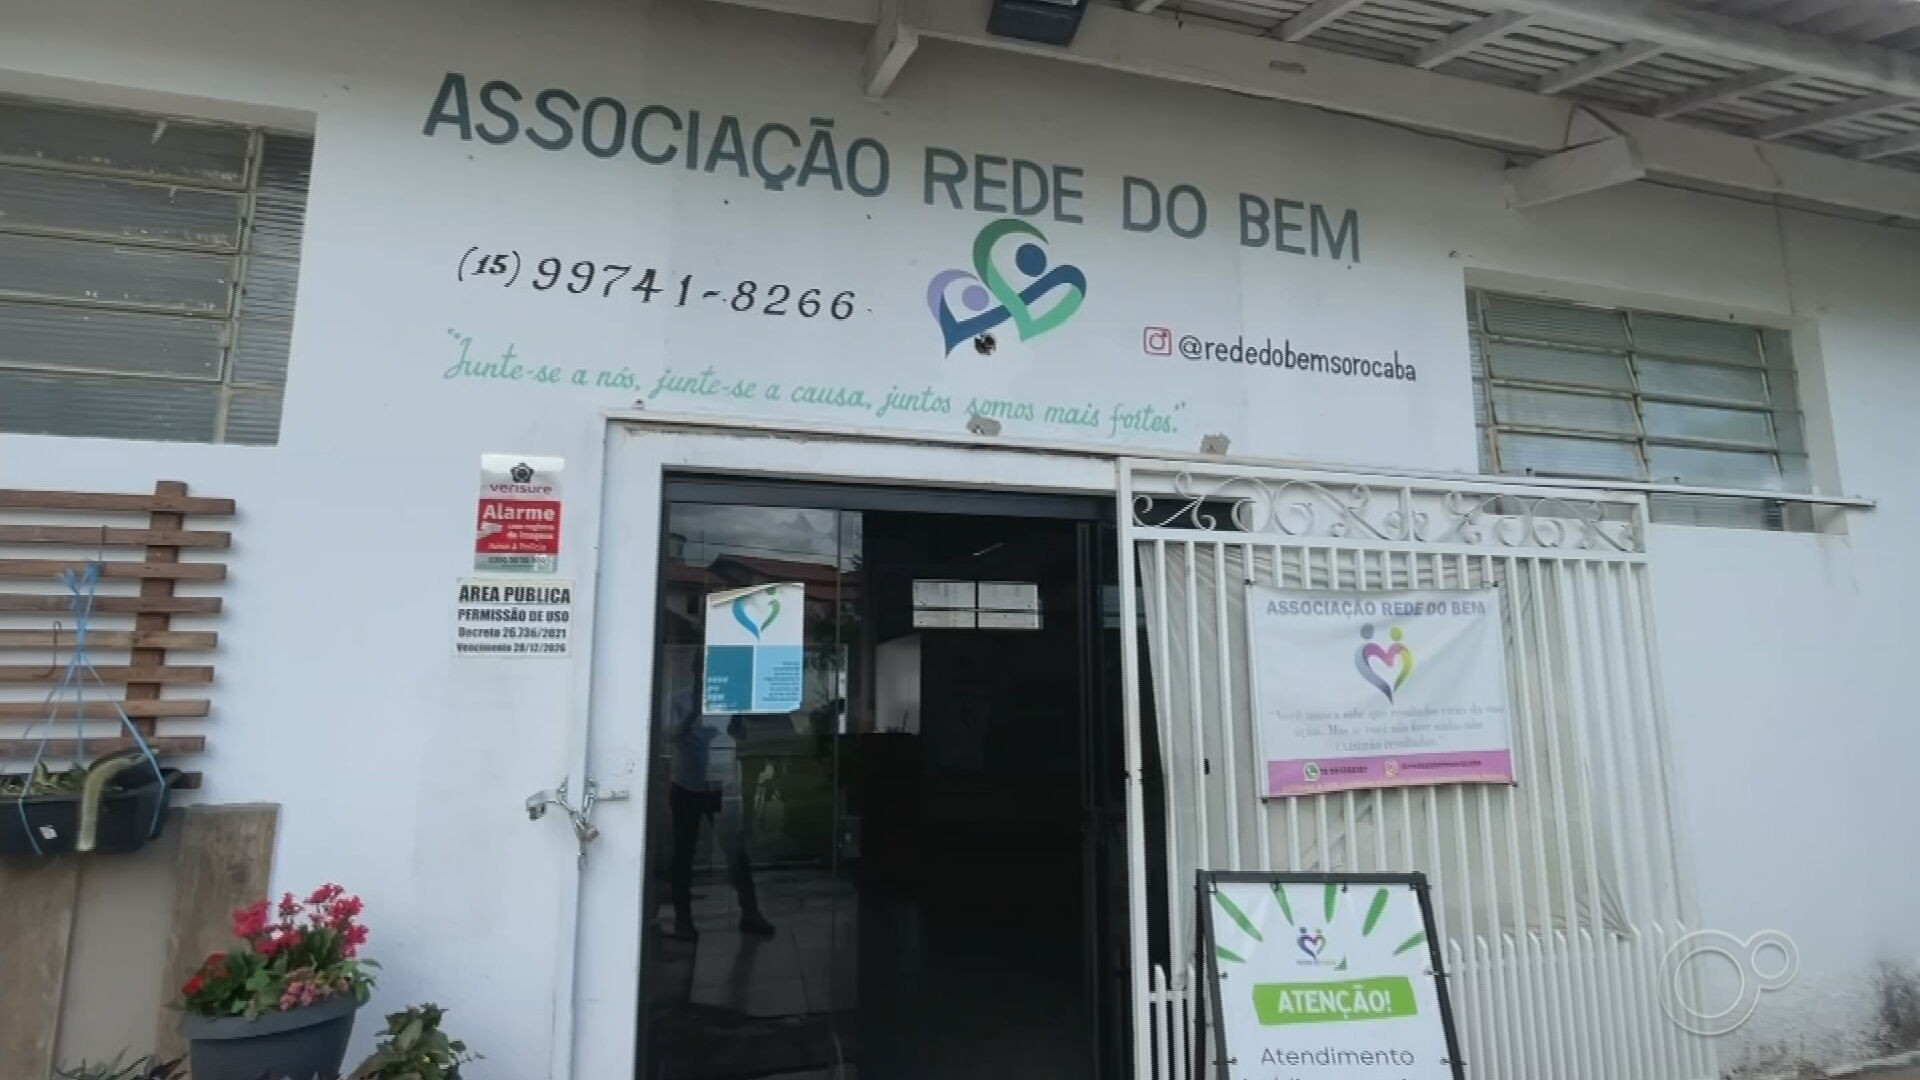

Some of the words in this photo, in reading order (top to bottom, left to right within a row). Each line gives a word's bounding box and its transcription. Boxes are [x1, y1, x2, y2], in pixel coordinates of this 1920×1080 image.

[421, 72, 891, 197] ASSOCIAÇÃO
[924, 146, 1085, 225] REDE
[1121, 176, 1208, 239] DO
[1239, 192, 1361, 264] BEM
[458, 246, 521, 287] (15)
[532, 257, 856, 320] 99741-8266
[1178, 334, 1417, 381] @rededobemsorocaba
[571, 367, 587, 385] a
[597, 366, 641, 391] nós,
[648, 365, 757, 400] junte-se
[765, 384, 780, 400] a
[790, 383, 871, 410] causa,
[876, 384, 951, 417] juntos
[966, 396, 1035, 422] somos
[1044, 402, 1100, 427] mais
[489, 484, 552, 494] verisure
[482, 503, 556, 521] Alarme
[458, 607, 526, 621] PERMISSÃO
[529, 610, 543, 621] DE
[546, 610, 569, 622] USO
[1266, 600, 1376, 618] ASSOCIAÇÃO
[1381, 601, 1422, 616] REDE
[1426, 601, 1447, 616] DO
[1451, 601, 1486, 616] BEM
[458, 627, 501, 638] Decreto
[1277, 985, 1392, 1020] ATENÇÃO!
[1260, 1047, 1415, 1066] Atendimento
